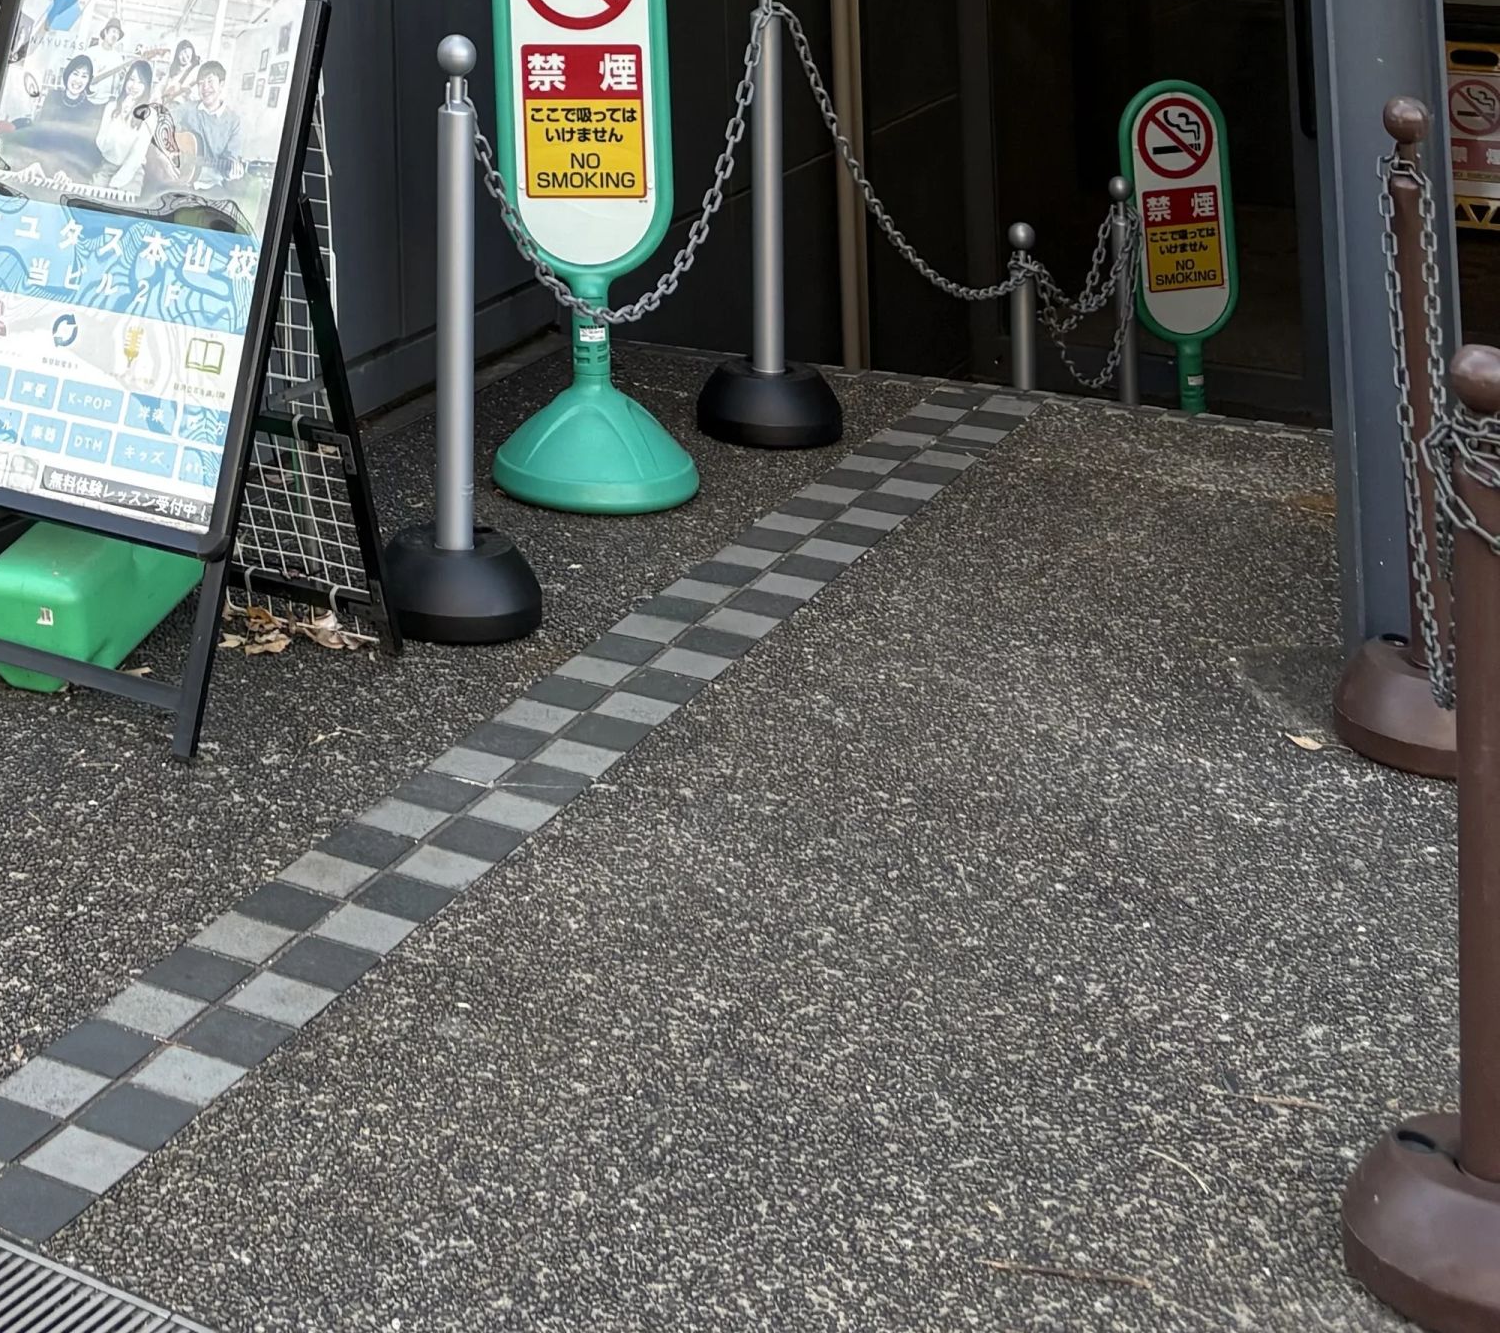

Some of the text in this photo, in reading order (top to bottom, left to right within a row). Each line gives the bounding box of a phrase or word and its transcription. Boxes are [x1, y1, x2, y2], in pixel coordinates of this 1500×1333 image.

[527, 52, 638, 92] 禁煙
[530, 107, 637, 123] ここで吸っては
[545, 127, 624, 143] いけません
[570, 152, 601, 169] NO
[537, 171, 636, 189] SMOKING
[1146, 192, 1216, 222] 禁煙
[1150, 227, 1216, 243] ここで吸っては
[1159, 241, 1208, 255] いけません
[1175, 259, 1195, 271] NO
[1156, 269, 1217, 286] SMOKING
[67, 393, 113, 412] K-POP
[73, 435, 104, 453] DTM
[124, 443, 166, 465] キッズ
